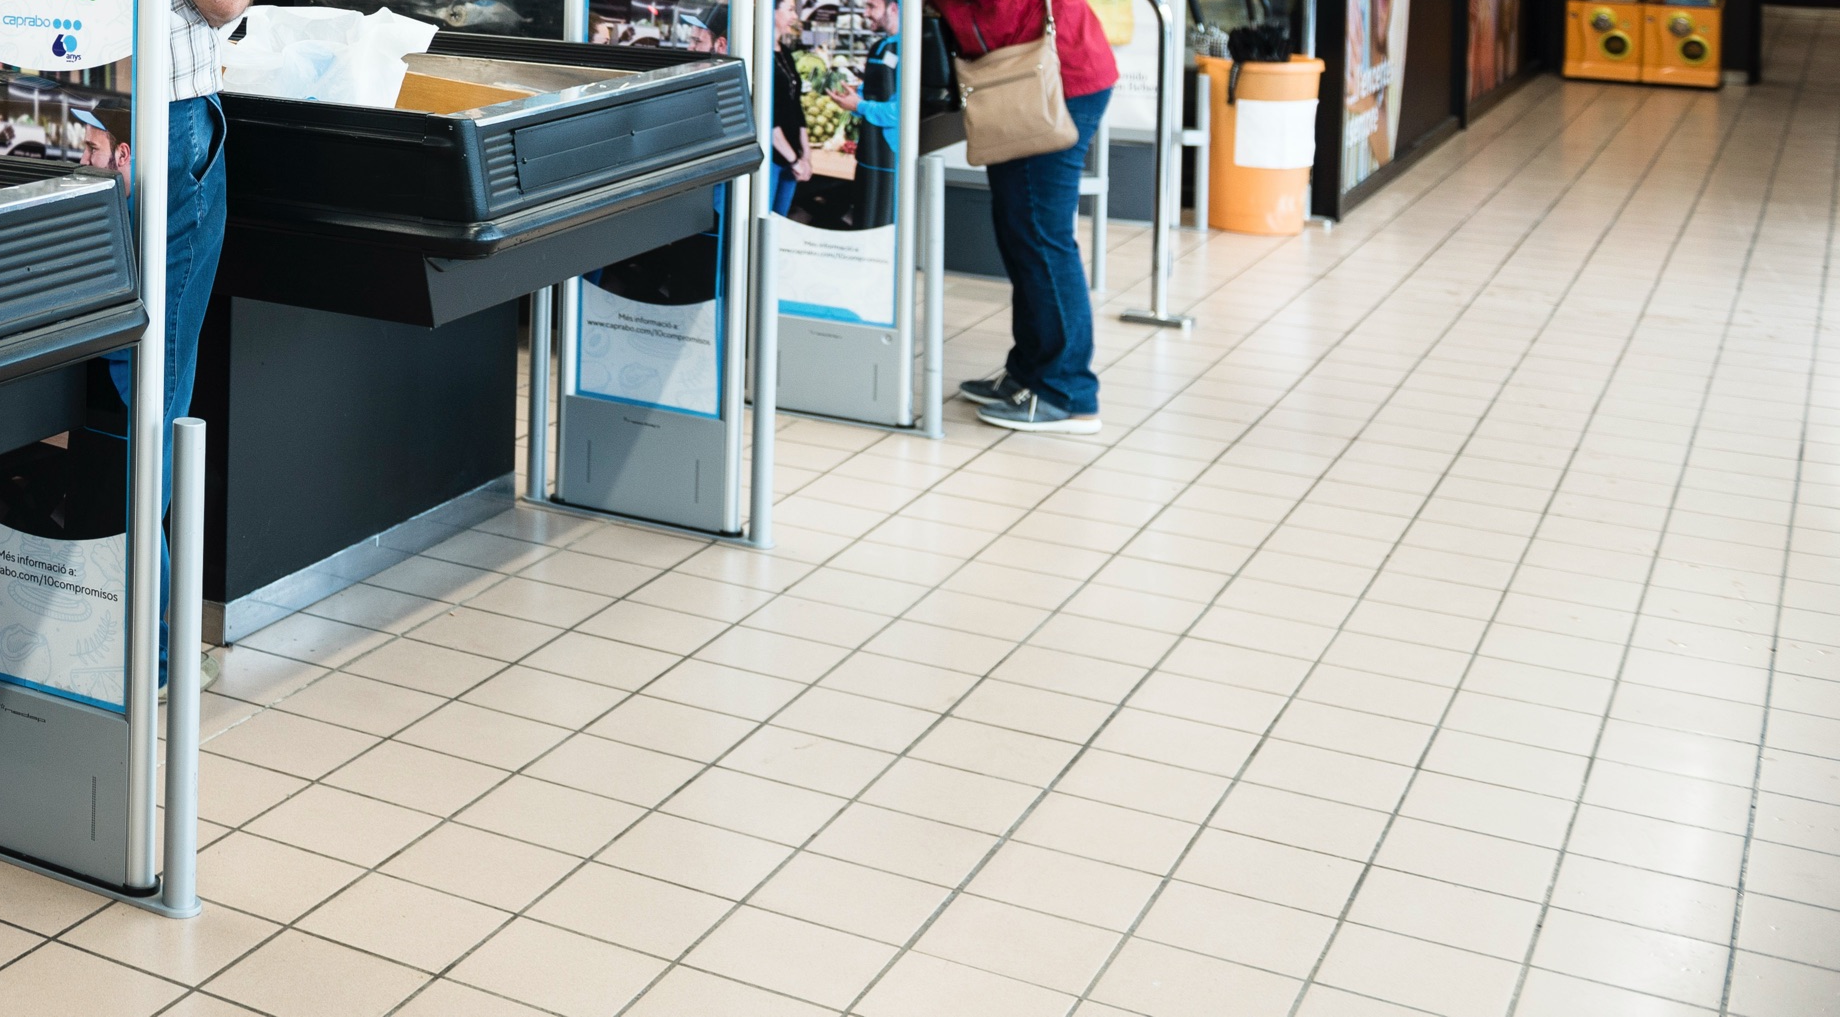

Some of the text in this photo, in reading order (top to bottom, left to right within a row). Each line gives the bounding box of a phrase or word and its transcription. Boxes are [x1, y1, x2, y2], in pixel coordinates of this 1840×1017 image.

[2, 15, 51, 29] caprabo
[66, 52, 82, 62] anys
[17, 553, 67, 574] informació
[68, 566, 77, 577] a:
